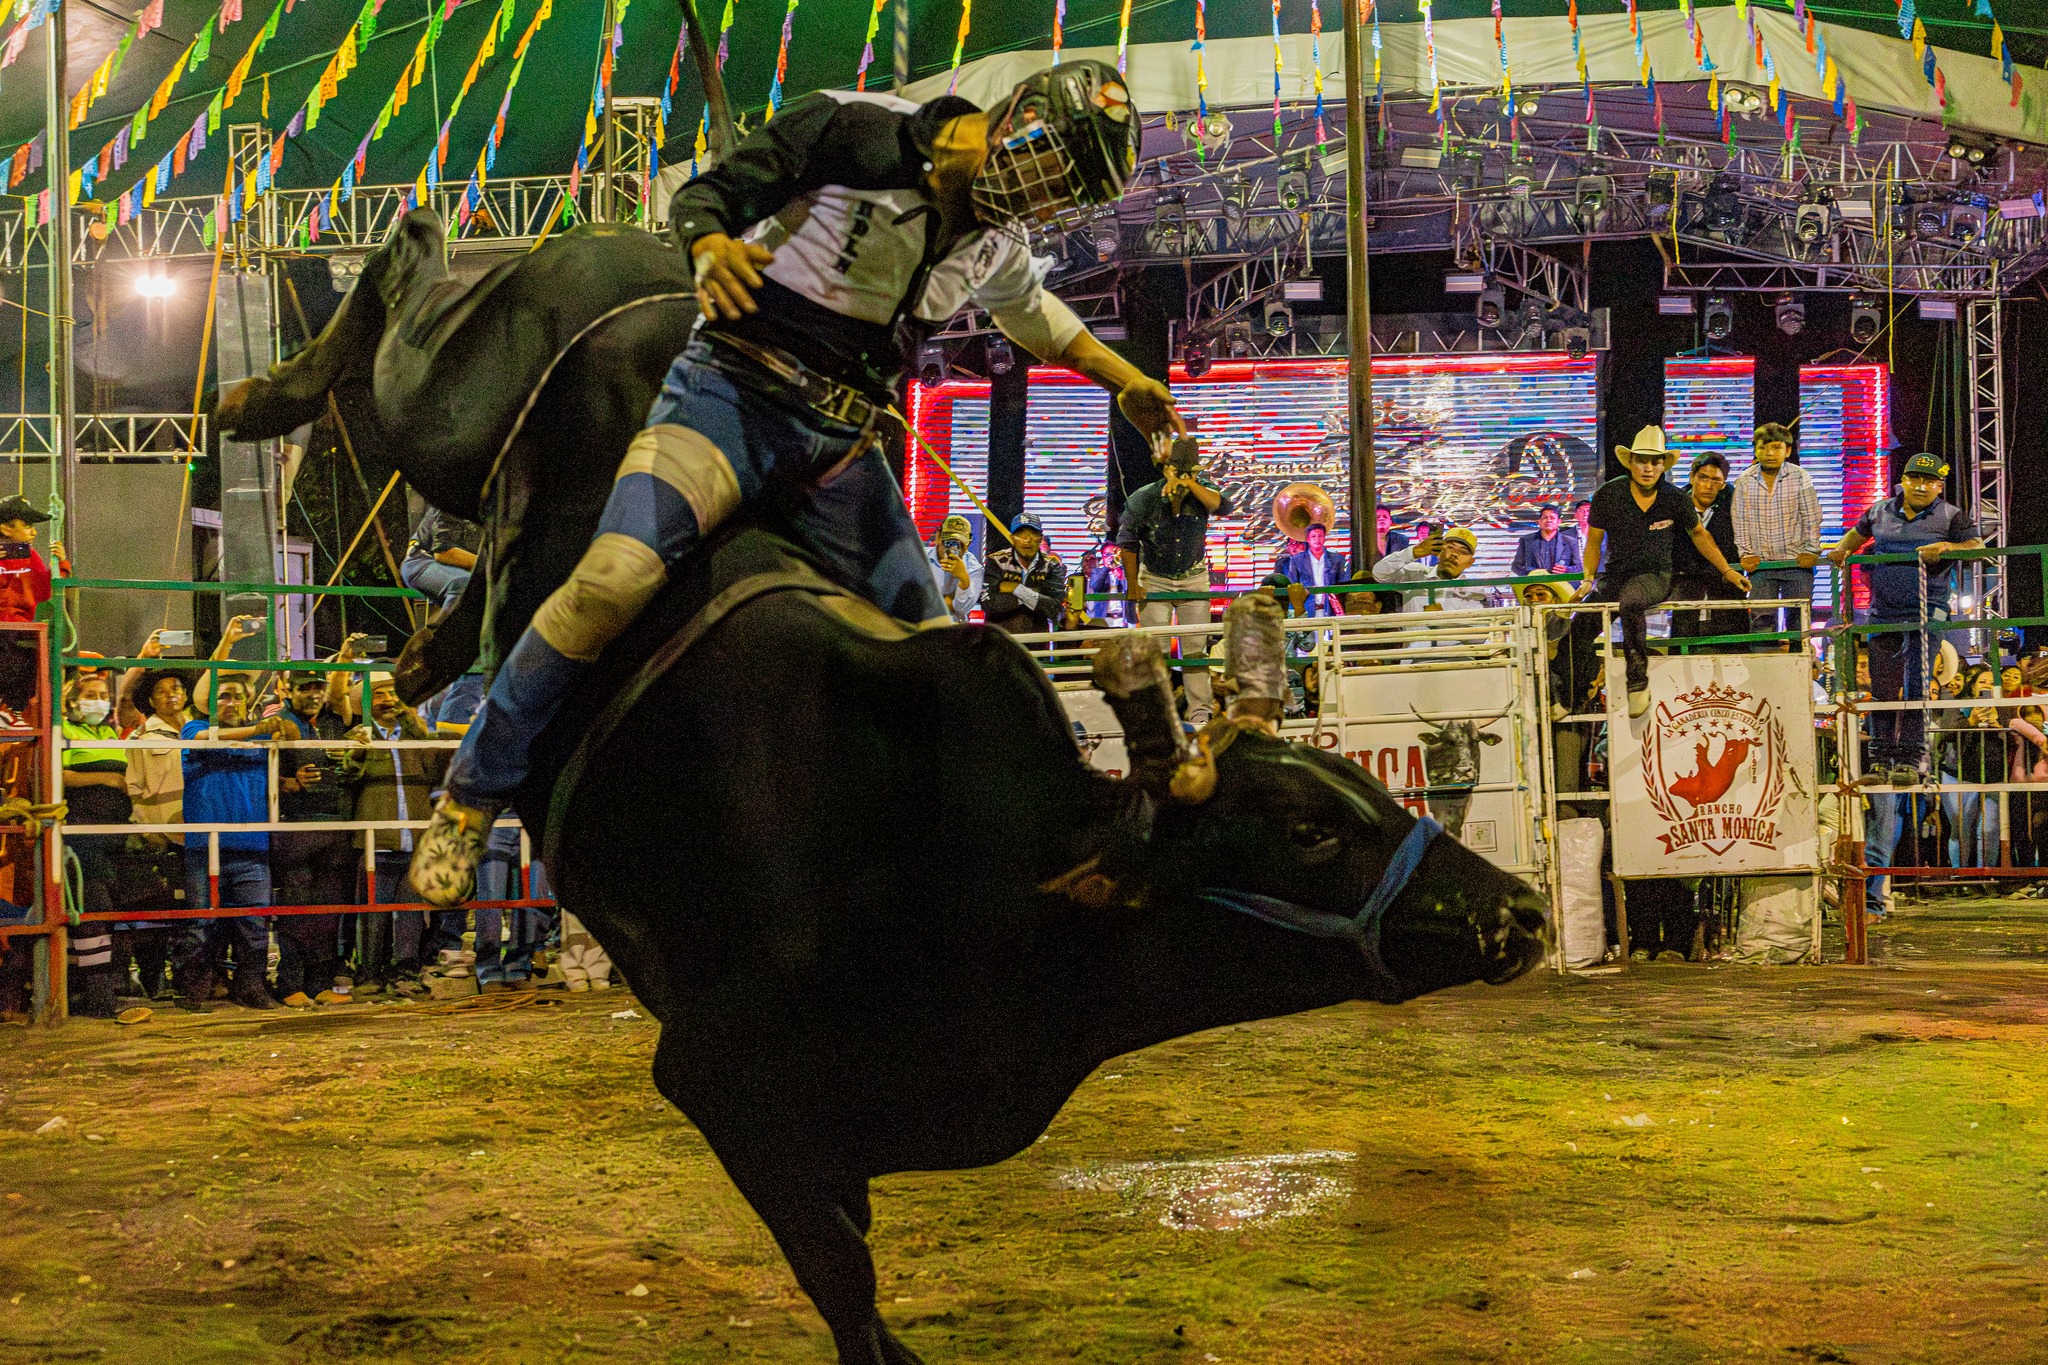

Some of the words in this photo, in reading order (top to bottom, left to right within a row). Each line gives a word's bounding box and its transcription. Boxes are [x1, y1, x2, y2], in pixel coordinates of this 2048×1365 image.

[1699, 803, 1743, 816] RANCHO
[1670, 818, 1717, 848] SANTA
[1722, 817, 1776, 845] MONICA
